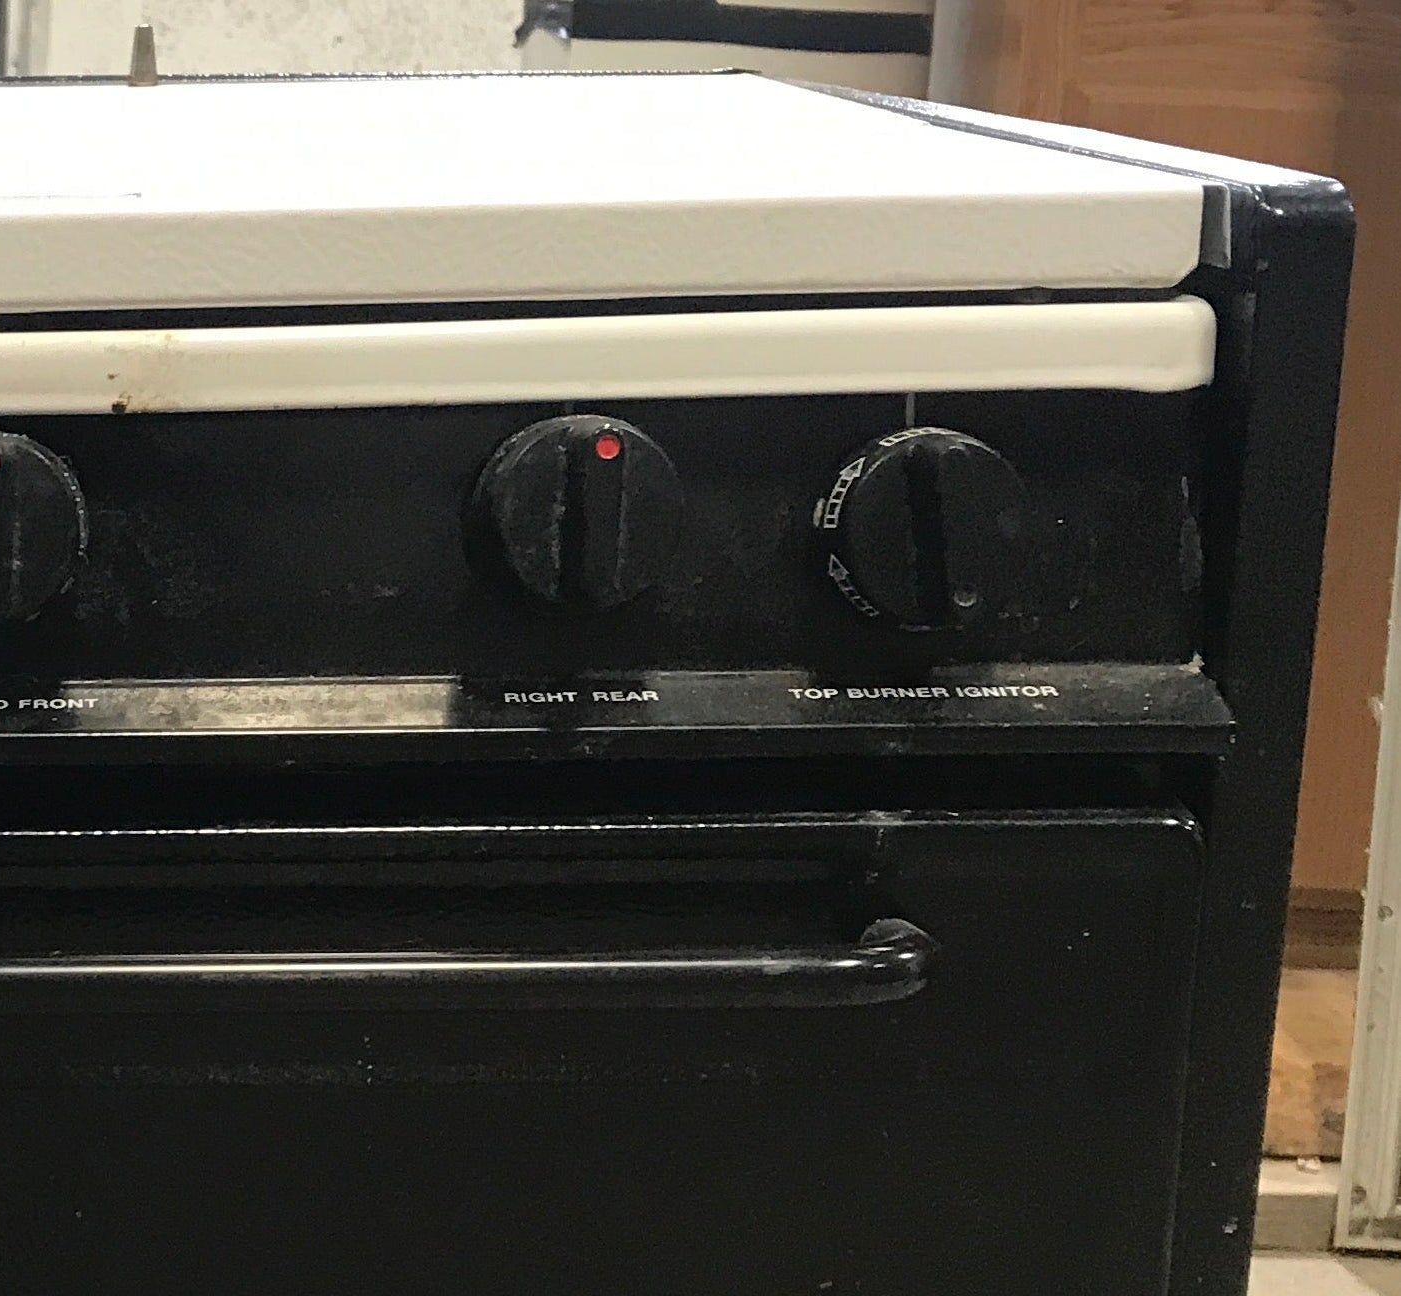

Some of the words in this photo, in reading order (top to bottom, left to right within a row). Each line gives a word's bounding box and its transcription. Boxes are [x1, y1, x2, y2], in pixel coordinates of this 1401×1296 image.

[504, 691, 578, 703] RIGHT
[592, 690, 660, 702] REAR
[788, 688, 839, 700] TOP
[847, 686, 950, 700] BURNER
[956, 685, 1060, 698] IGNITOR
[18, 698, 99, 710] FRONT
